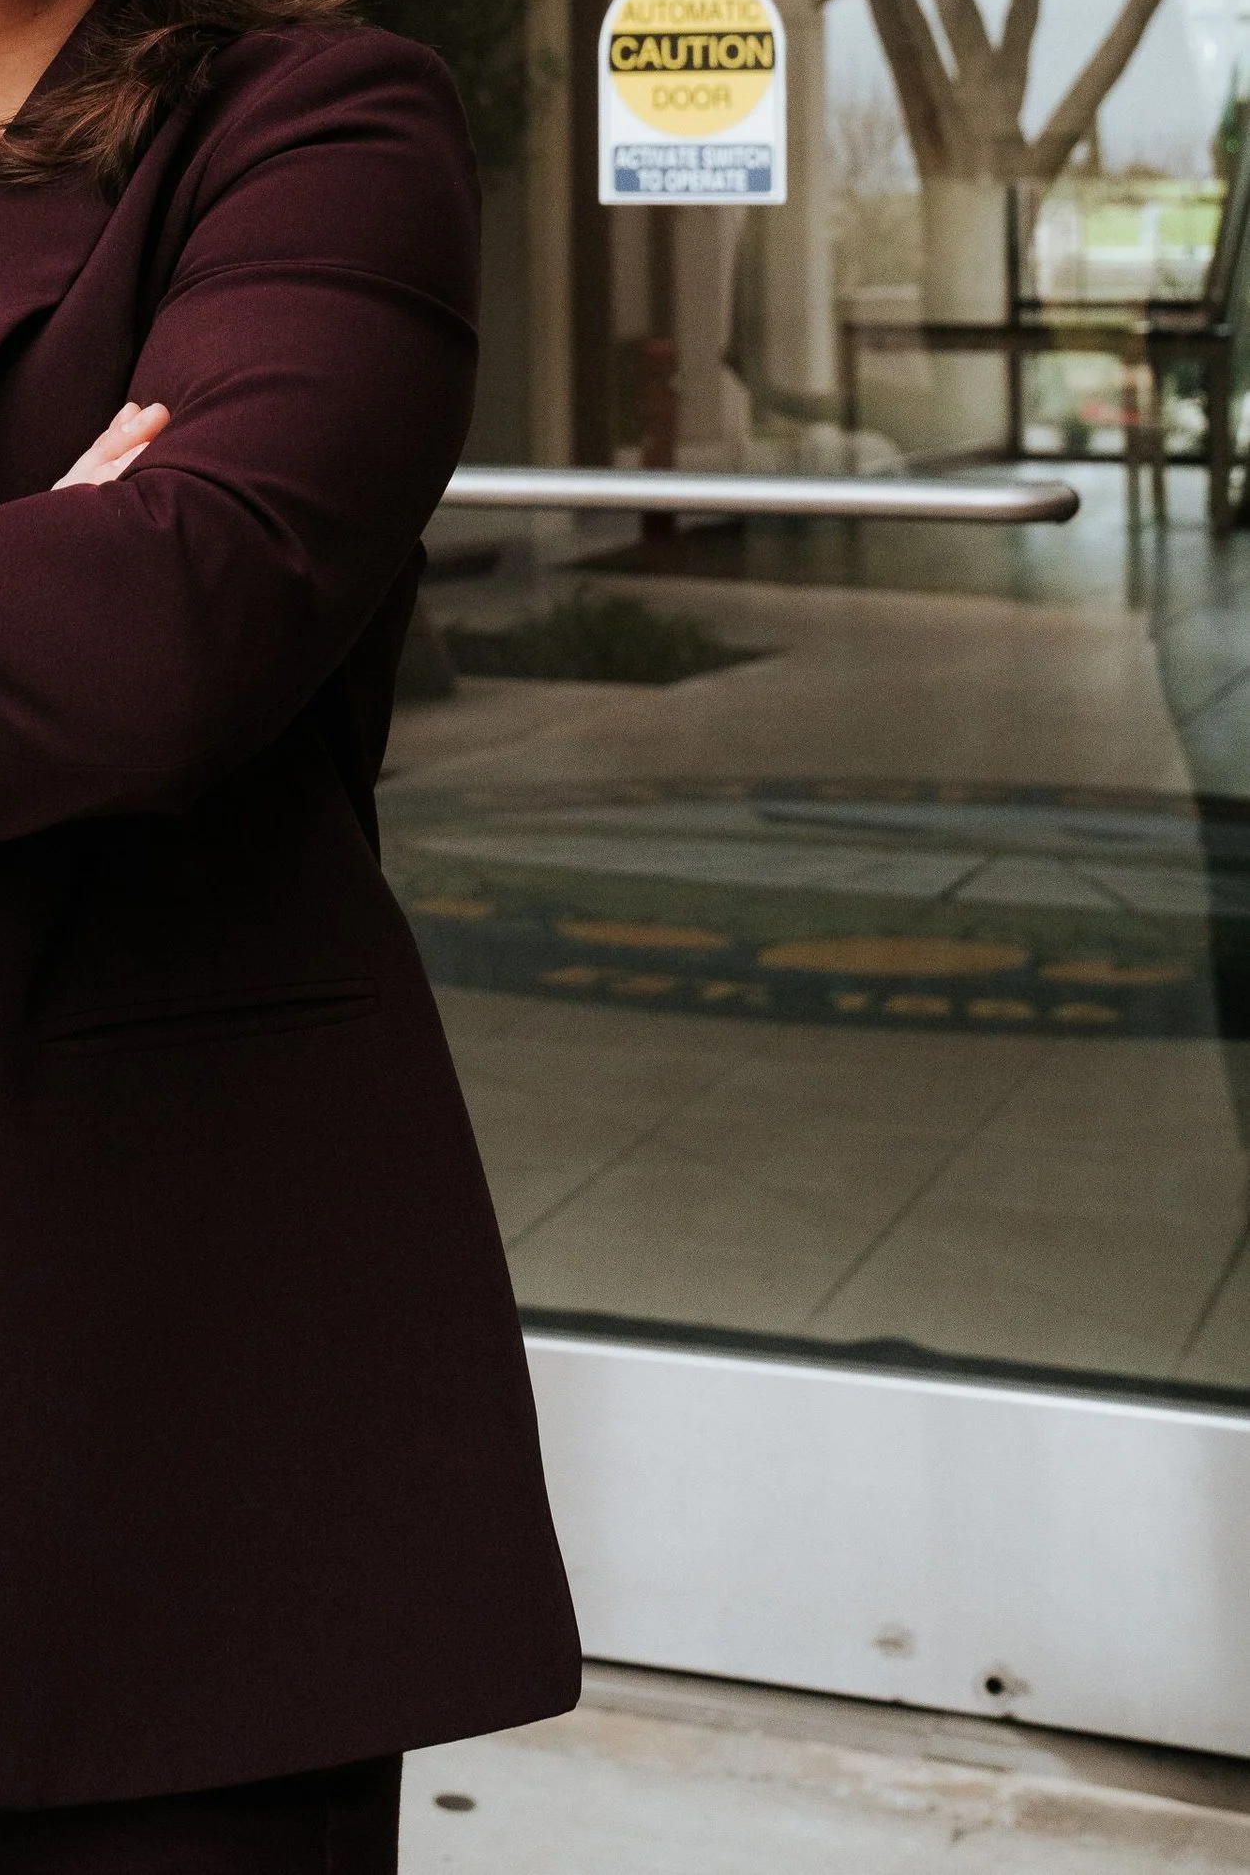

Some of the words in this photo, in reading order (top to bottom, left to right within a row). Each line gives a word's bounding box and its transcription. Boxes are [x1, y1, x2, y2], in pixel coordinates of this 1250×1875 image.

[611, 34, 773, 70] CAUTION
[651, 84, 733, 111] DOOR
[637, 168, 664, 193] TO
[664, 167, 748, 193] OPERATE
